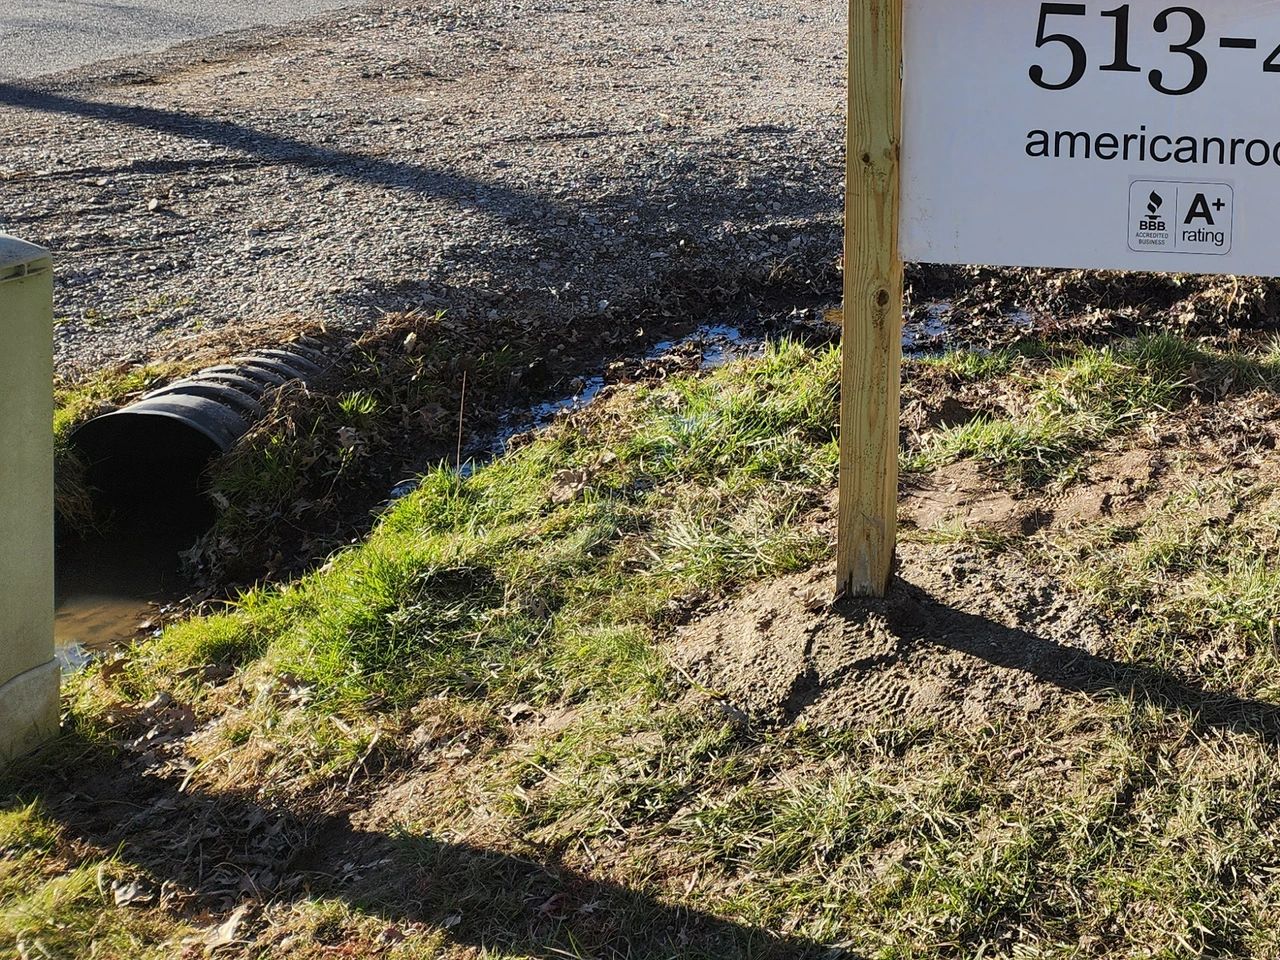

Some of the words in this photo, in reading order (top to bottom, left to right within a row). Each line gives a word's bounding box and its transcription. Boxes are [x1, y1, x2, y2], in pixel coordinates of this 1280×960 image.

[1183, 192, 1226, 225] A+
[1139, 220, 1166, 231] BBB
[1182, 228, 1224, 246] rating
